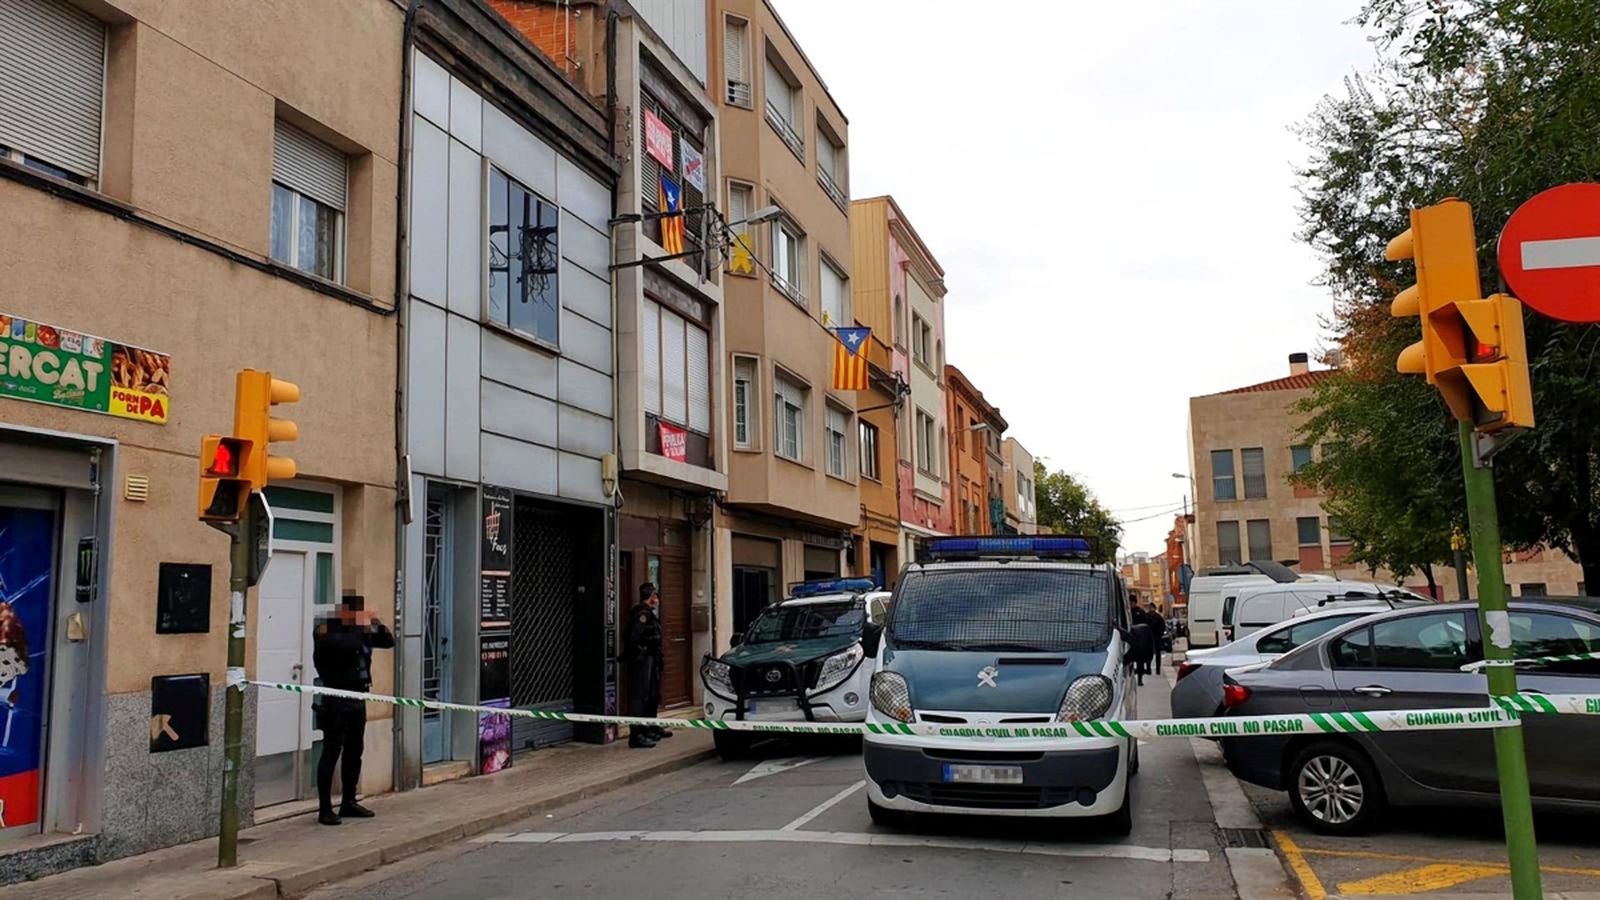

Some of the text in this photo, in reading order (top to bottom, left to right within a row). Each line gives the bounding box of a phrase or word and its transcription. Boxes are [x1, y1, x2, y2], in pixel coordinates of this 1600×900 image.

[112, 390, 140, 404] FORN
[126, 395, 165, 419] DE PA
[1406, 711, 1464, 726] GUARDIA
[1468, 709, 1503, 723] CIVIL
[939, 727, 1068, 737] GUARDIA CIVIL NO PASAR
[1156, 719, 1304, 736] GUARDIA CIVIL NO PASAR
